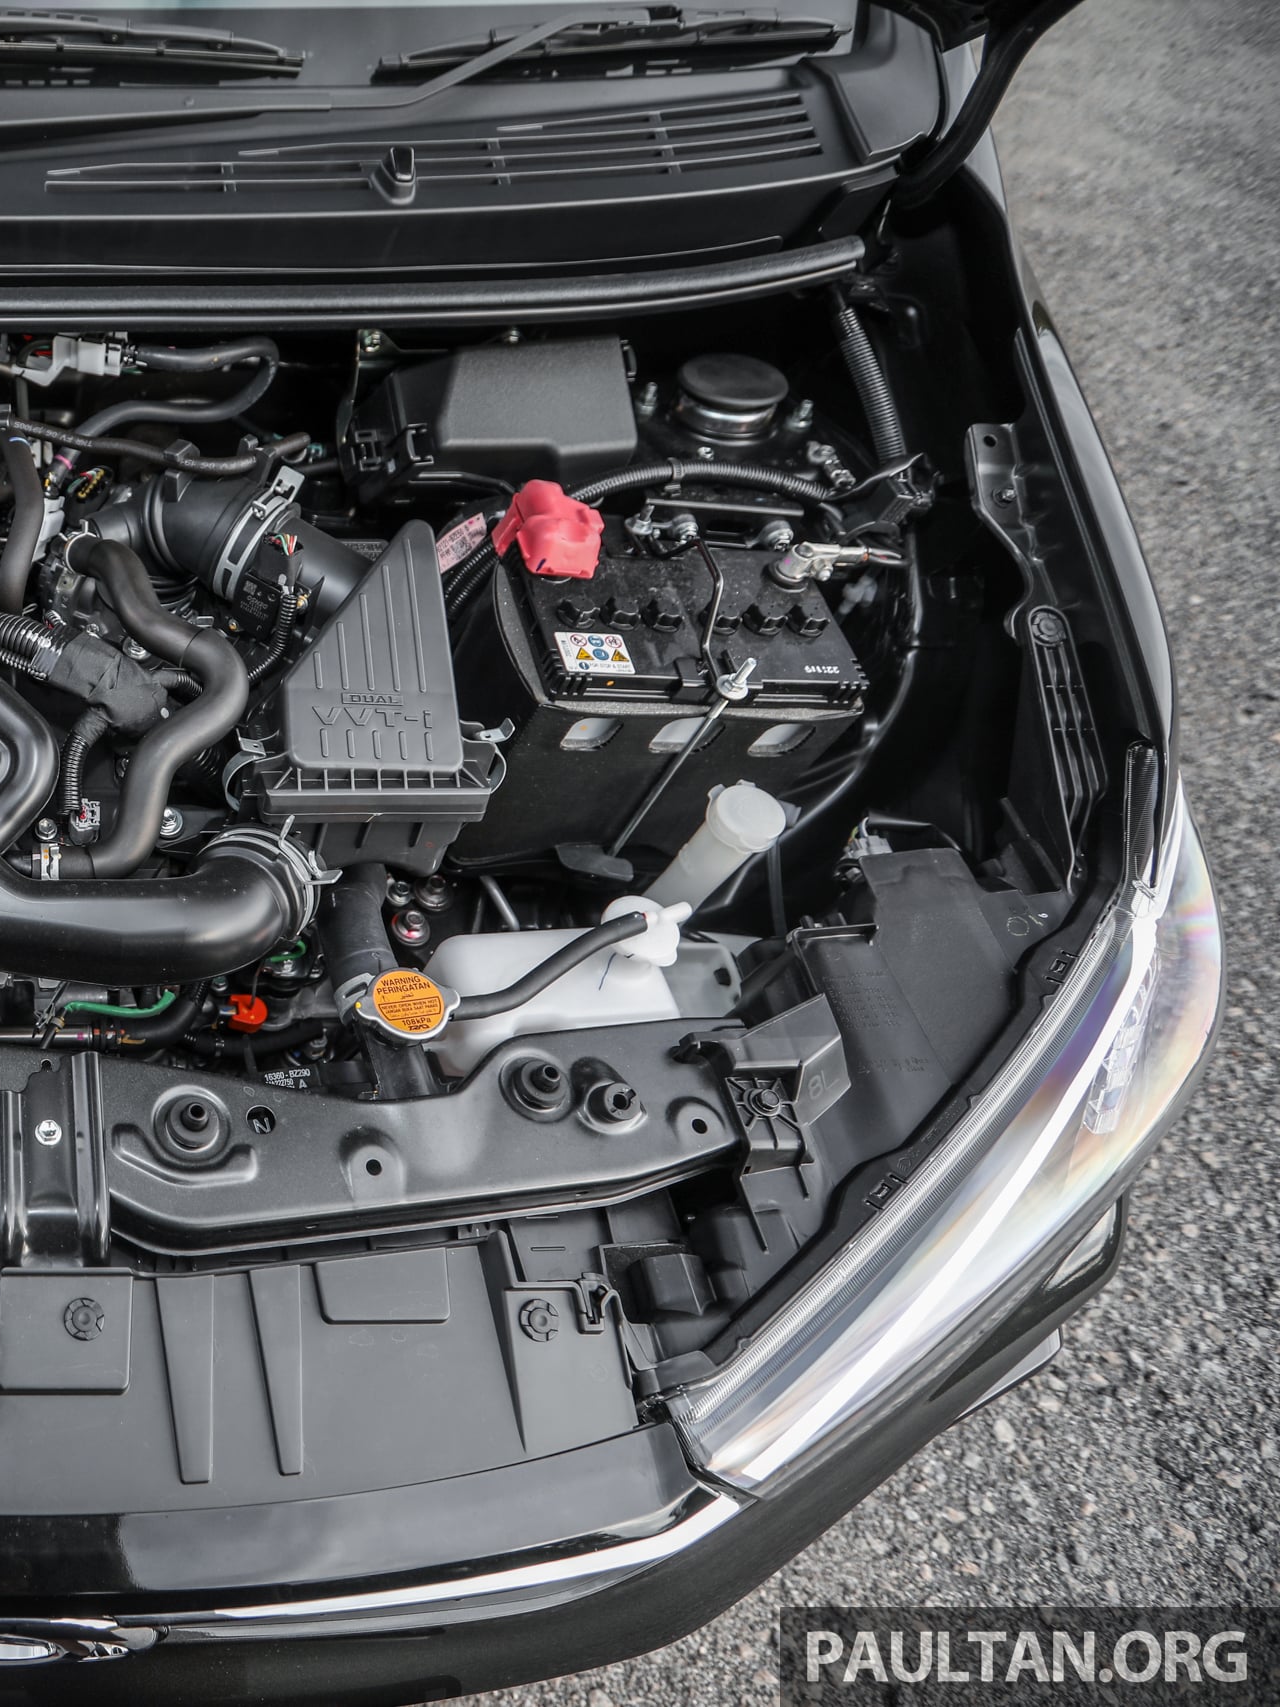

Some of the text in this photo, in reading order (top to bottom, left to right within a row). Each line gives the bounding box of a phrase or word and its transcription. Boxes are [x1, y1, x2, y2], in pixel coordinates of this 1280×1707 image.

[349, 694, 399, 704] DUAL
[381, 975, 421, 987] WARNING
[376, 982, 431, 995] PERINGATAN
[401, 1017, 432, 1026] 108kPa
[298, 1078, 308, 1089] A
[808, 1070, 840, 1100] 8L
[252, 1116, 271, 1134] N
